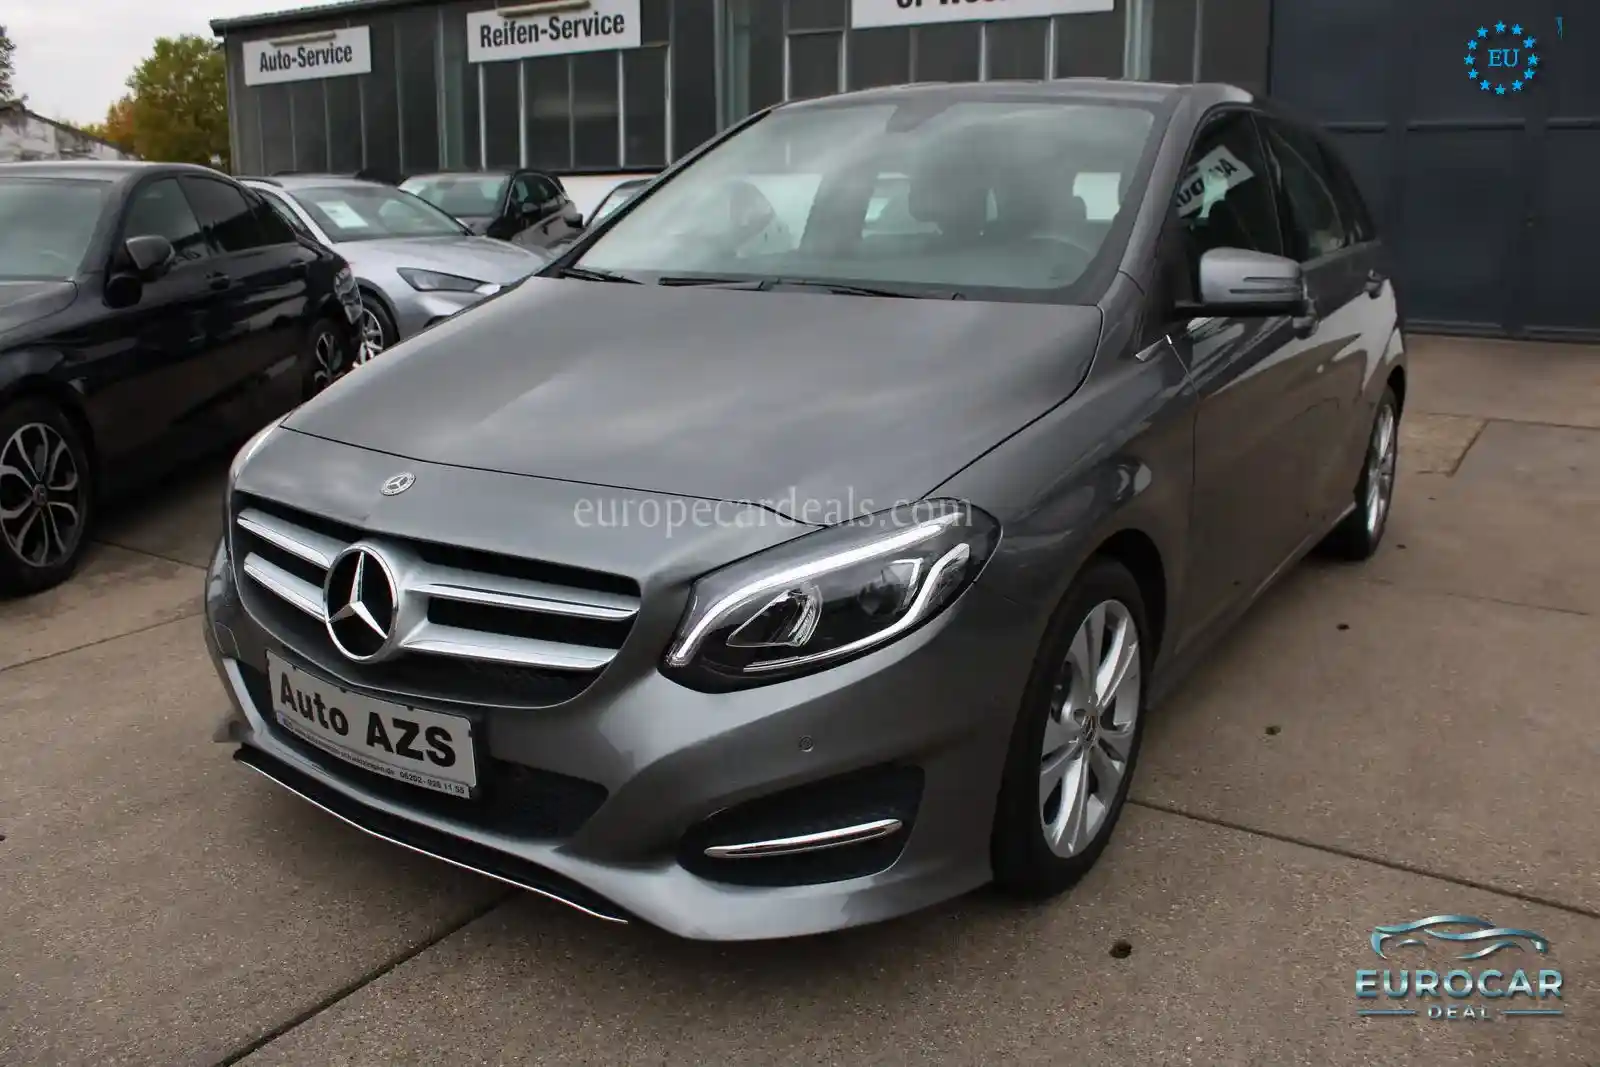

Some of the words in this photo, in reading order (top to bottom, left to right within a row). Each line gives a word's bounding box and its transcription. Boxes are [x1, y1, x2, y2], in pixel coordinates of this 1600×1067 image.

[480, 11, 625, 48] Reifen-Service
[259, 42, 353, 73] Auto-Service
[280, 671, 349, 737] Auto
[366, 710, 456, 768] AZS
